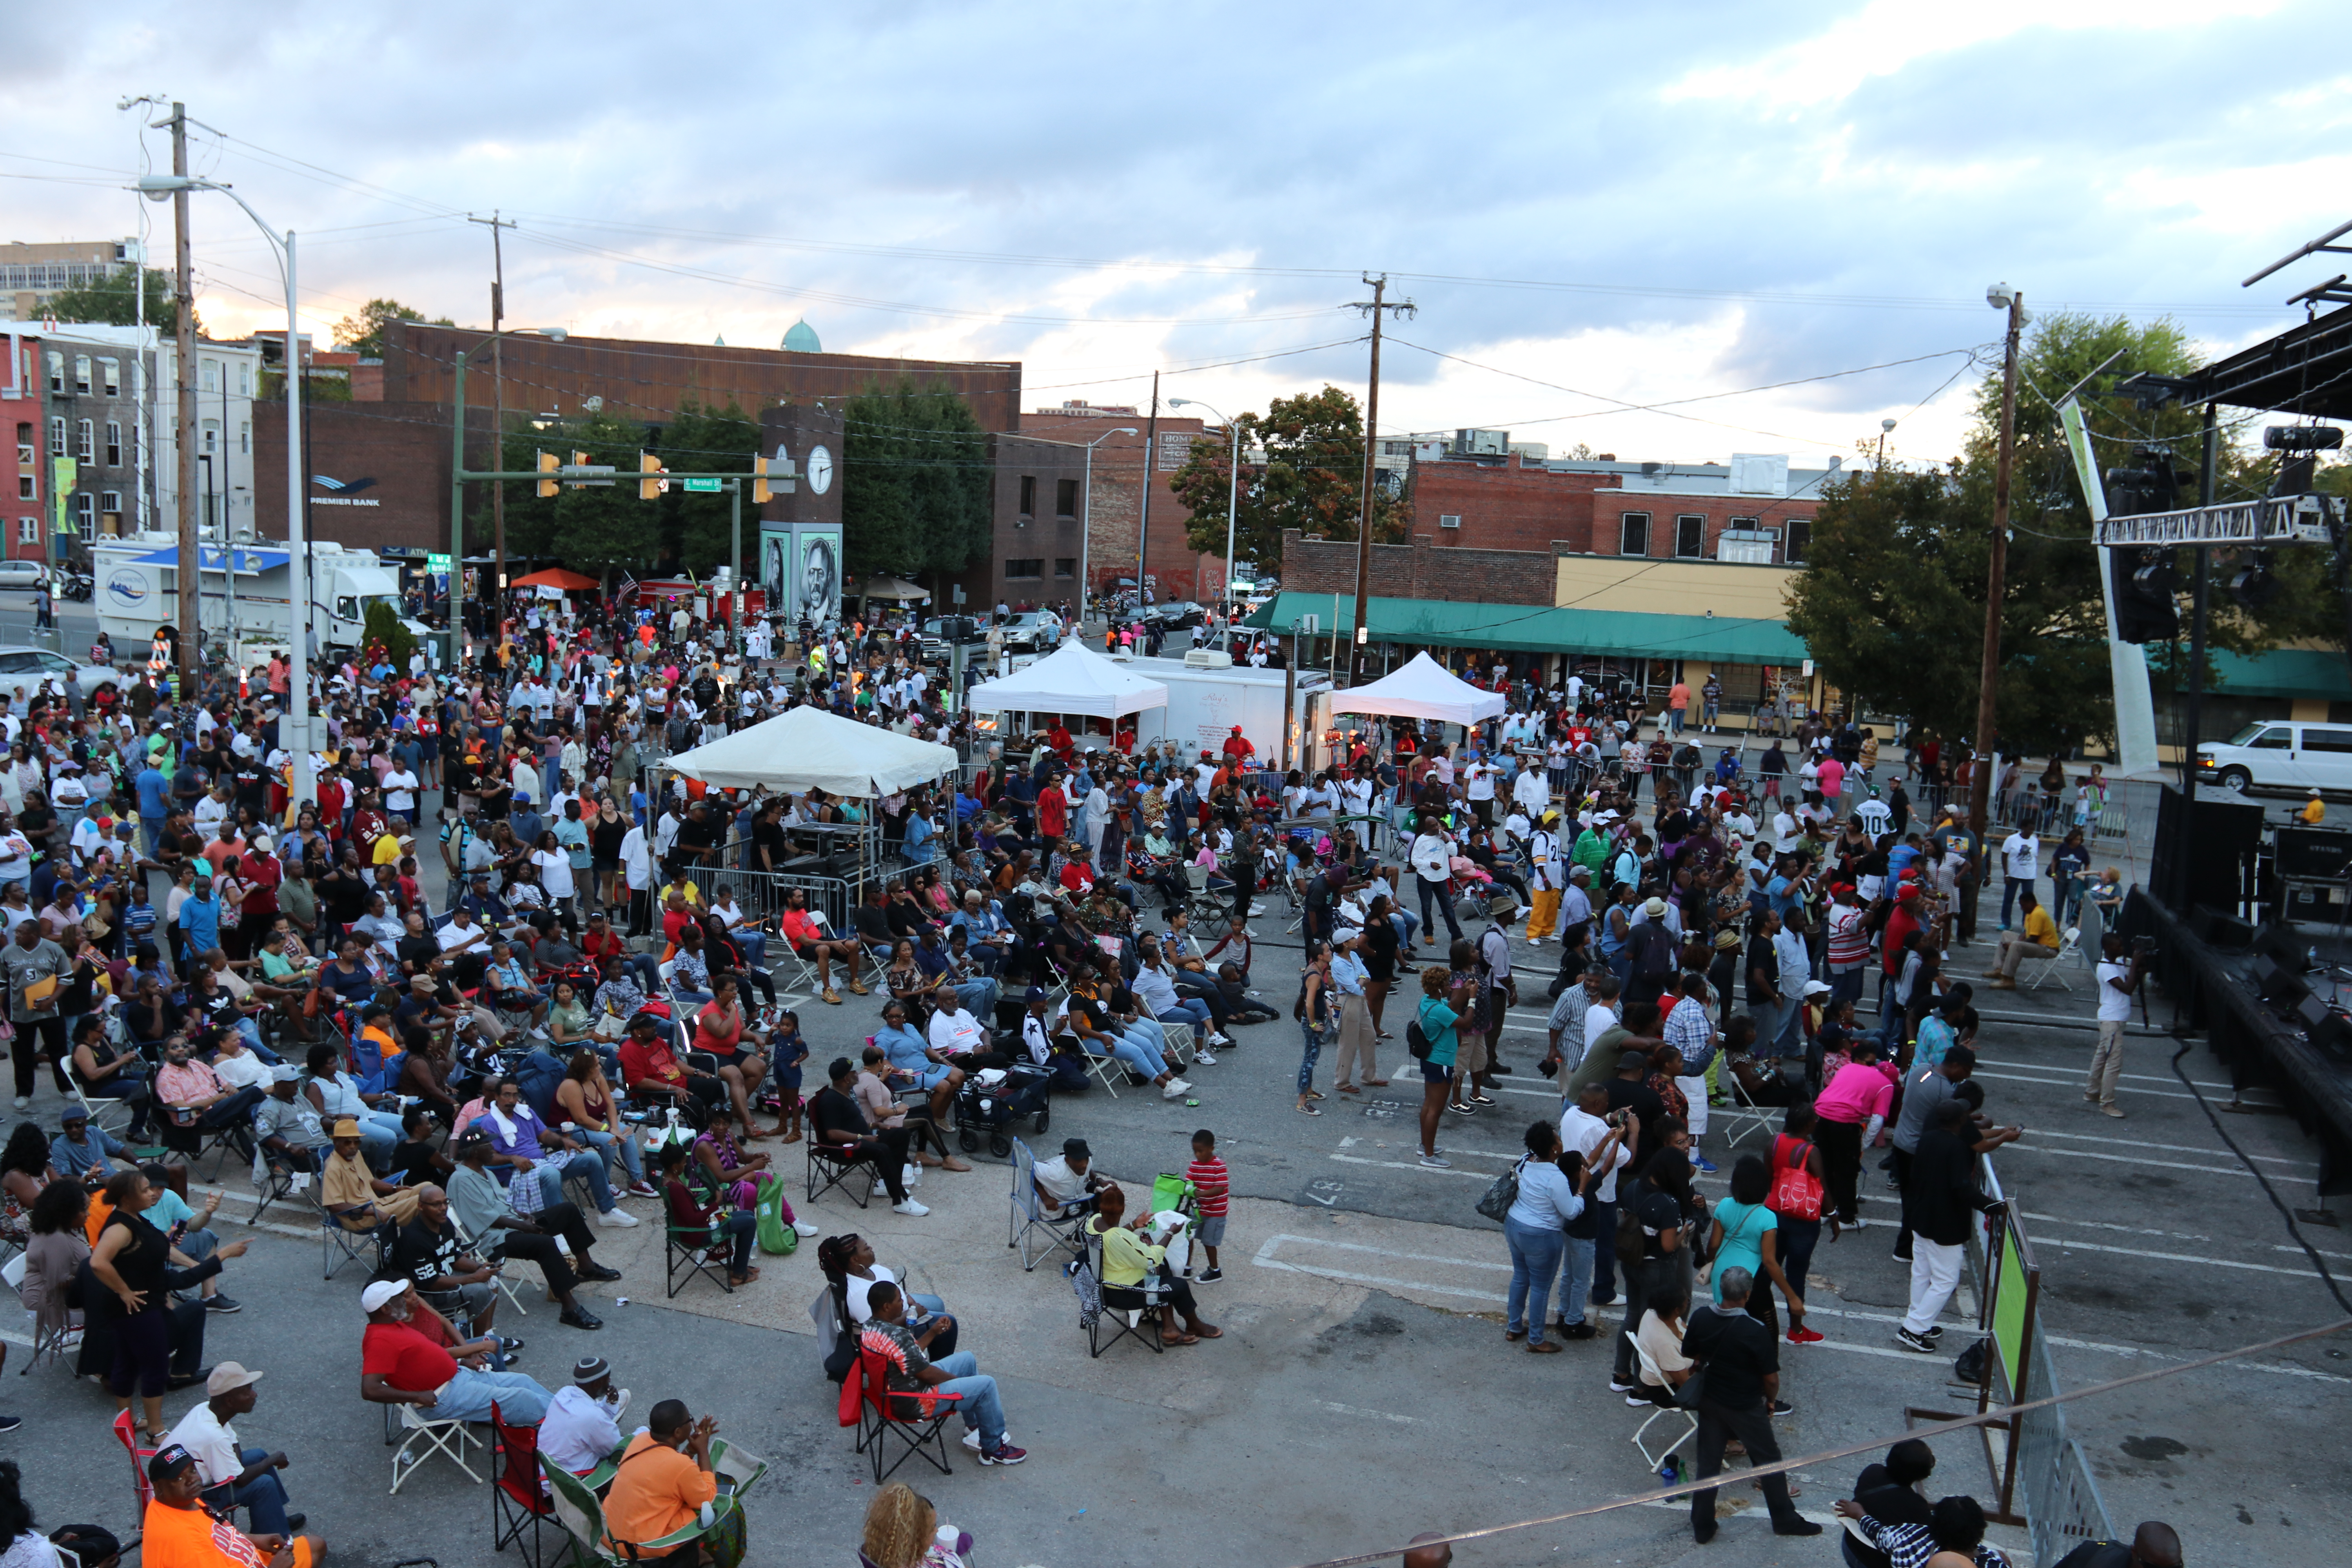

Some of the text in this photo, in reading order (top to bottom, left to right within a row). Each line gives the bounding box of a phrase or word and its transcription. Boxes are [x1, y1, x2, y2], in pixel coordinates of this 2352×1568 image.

[310, 497, 351, 506] PREMIER
[409, 548, 428, 557] ATM
[755, 637, 759, 646] 7
[1202, 692, 1227, 704] Ray's
[1865, 815, 1881, 835] 10
[953, 1025, 971, 1034] POLO
[414, 1263, 437, 1281] 52
